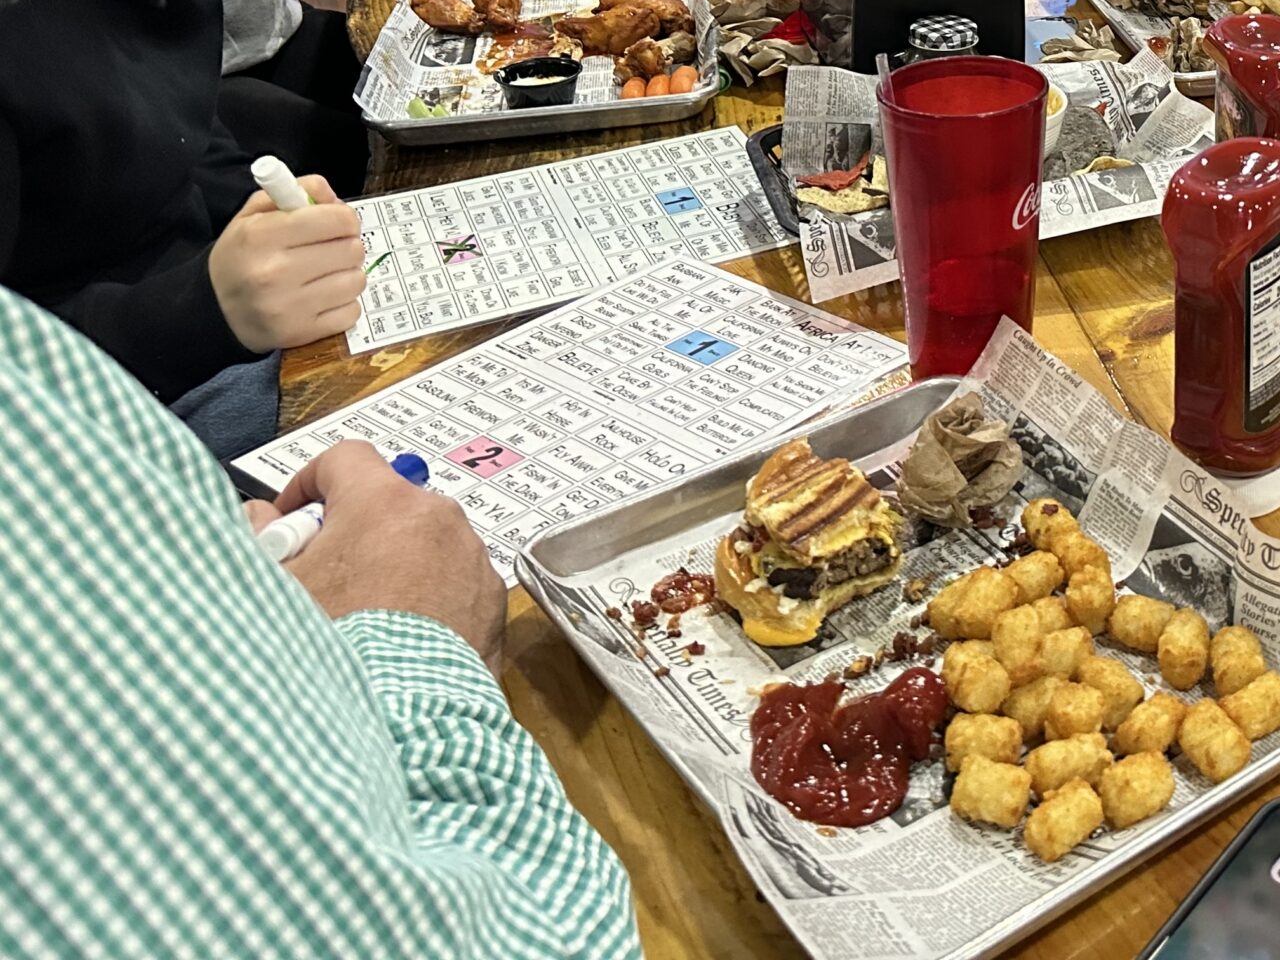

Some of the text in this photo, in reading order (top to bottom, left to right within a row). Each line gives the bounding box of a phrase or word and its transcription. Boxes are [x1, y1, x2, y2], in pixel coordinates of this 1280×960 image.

[671, 263, 706, 281] BARBARA
[716, 326, 741, 340] LOVE
[723, 314, 765, 336] CALIFORNIA
[794, 320, 840, 344] AFRICA
[687, 339, 719, 356] 1
[557, 351, 603, 377] BELIEVE
[724, 364, 756, 382] QUEEN
[737, 353, 776, 374] DANCING
[1056, 366, 1083, 389] Crowd
[416, 380, 457, 403] GASOLINA
[498, 387, 527, 405] PARTY
[458, 399, 502, 425] FIREWORK
[738, 397, 786, 422] COMPLICATED
[341, 416, 380, 440] ELECTRIC
[601, 419, 647, 445] JAILHOUSE
[590, 433, 619, 452] ROCK
[462, 446, 504, 469] 2
[548, 444, 598, 473] FLY AWAY
[459, 489, 515, 523] HEY YA!
[687, 668, 741, 721] Times
